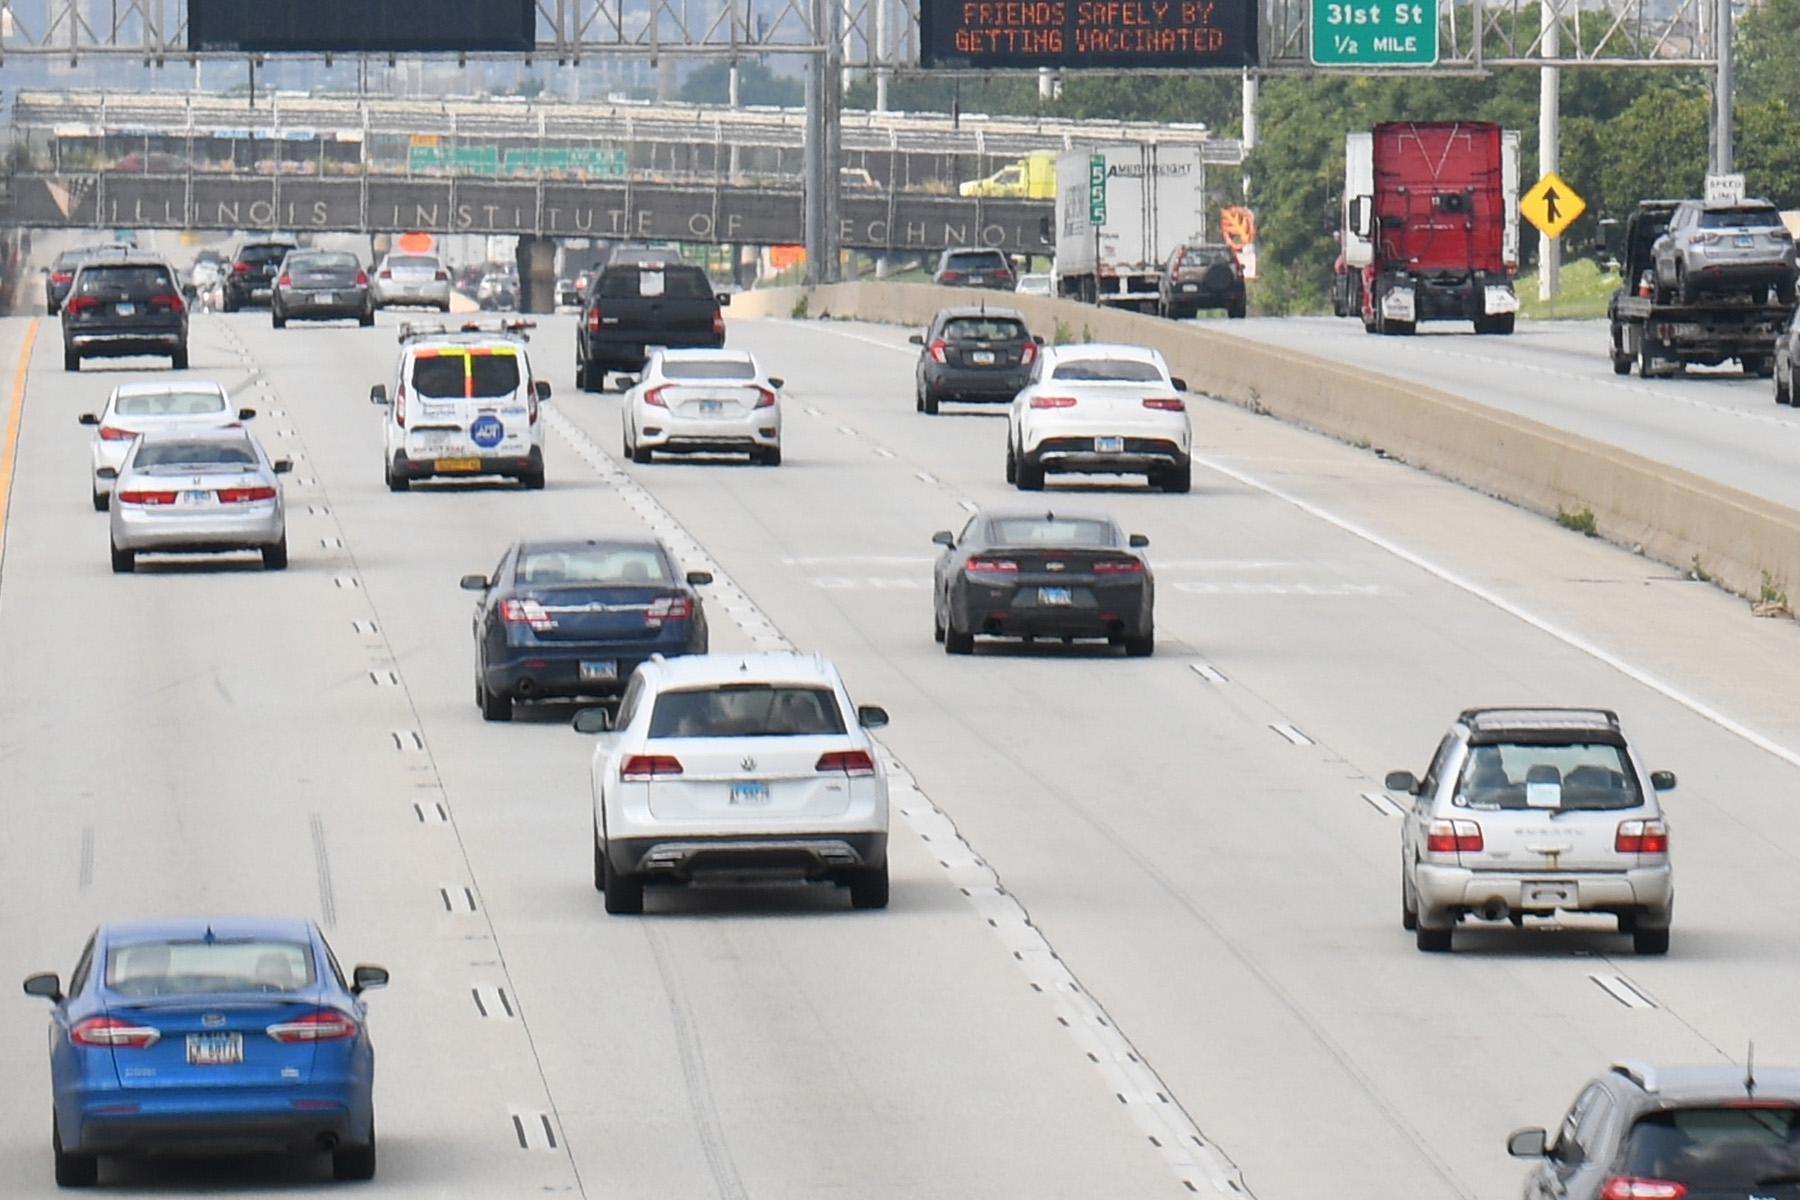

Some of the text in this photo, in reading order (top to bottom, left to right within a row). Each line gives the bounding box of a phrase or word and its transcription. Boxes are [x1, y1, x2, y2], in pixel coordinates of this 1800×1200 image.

[963, 2, 1215, 26] FRIENDS SAFELY BY
[1327, 3, 1422, 24] 31st St
[955, 29, 1223, 53] GETTING VACCINATED
[1374, 36, 1417, 52] MILE
[112, 199, 1023, 248] ILLINOIS INSTITUTE OF ECHNOL
